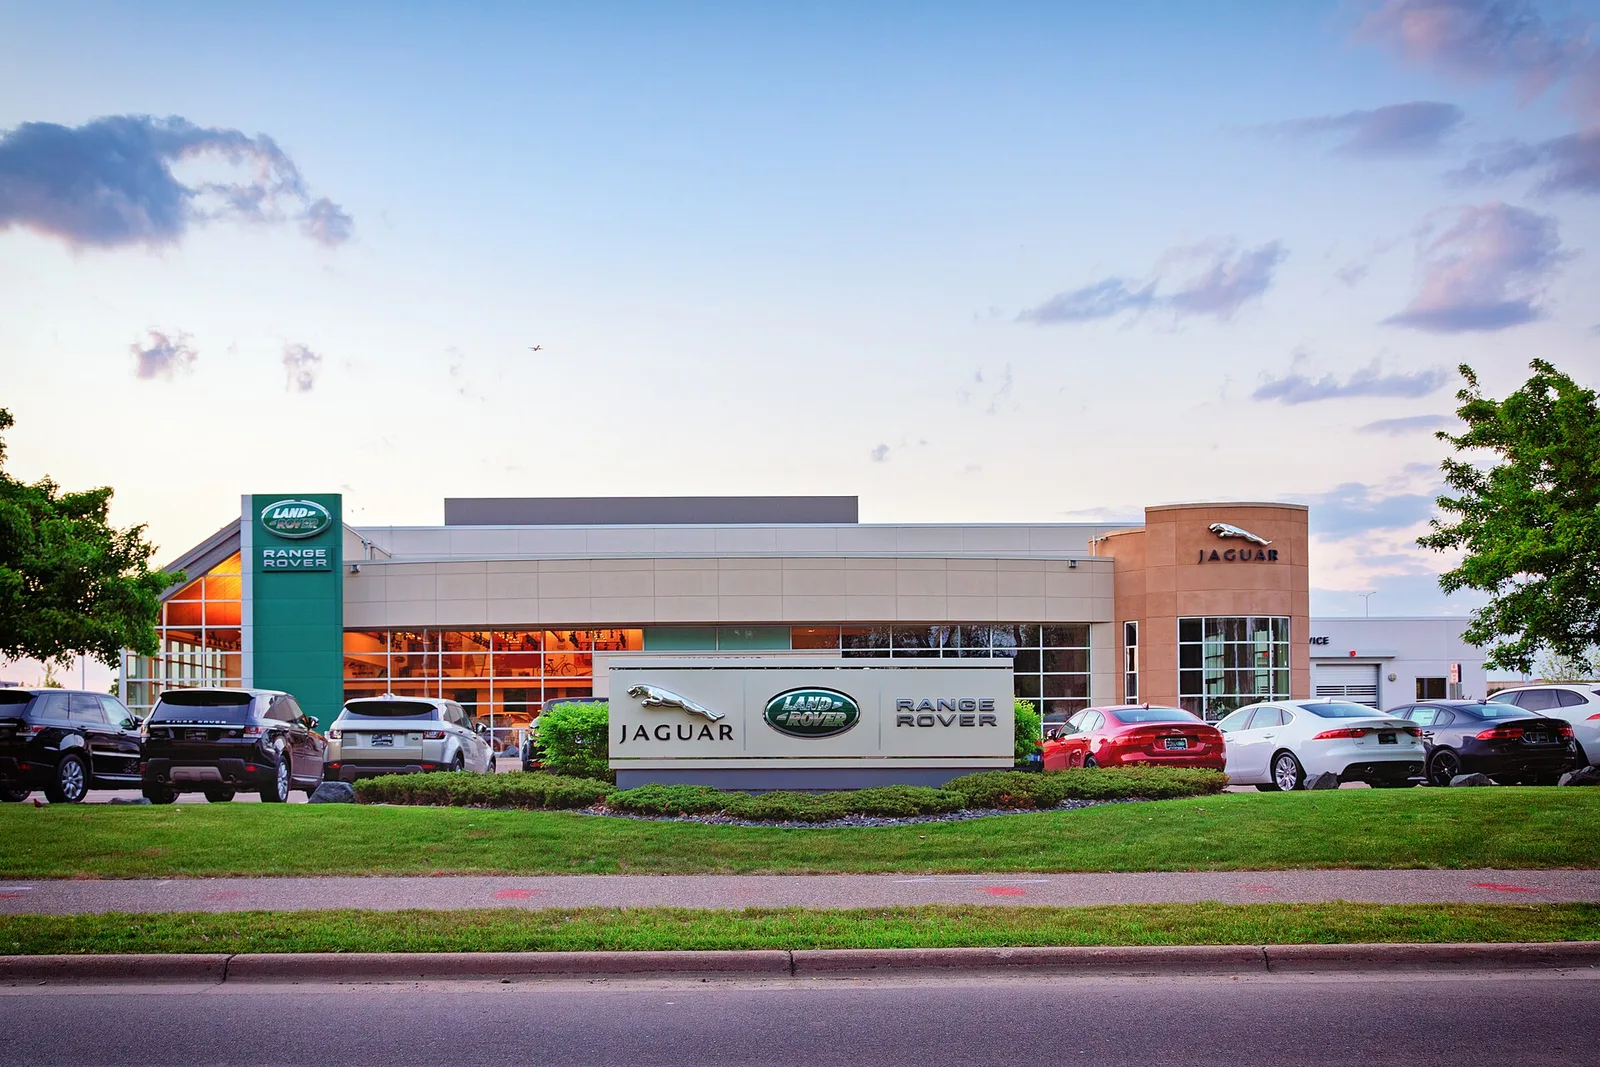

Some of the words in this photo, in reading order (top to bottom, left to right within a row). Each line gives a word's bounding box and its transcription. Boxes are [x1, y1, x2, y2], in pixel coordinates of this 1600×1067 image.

[273, 508, 308, 519] LAND
[276, 518, 319, 529] ROVER
[263, 549, 326, 558] RANGE
[1198, 549, 1279, 564] JAGUAR
[263, 559, 327, 567] ROVER
[782, 696, 832, 711] LAND
[896, 698, 995, 711] RANGE
[786, 711, 847, 727] ROVER
[896, 714, 997, 727] ROVER
[619, 724, 734, 744] JAGUAR
